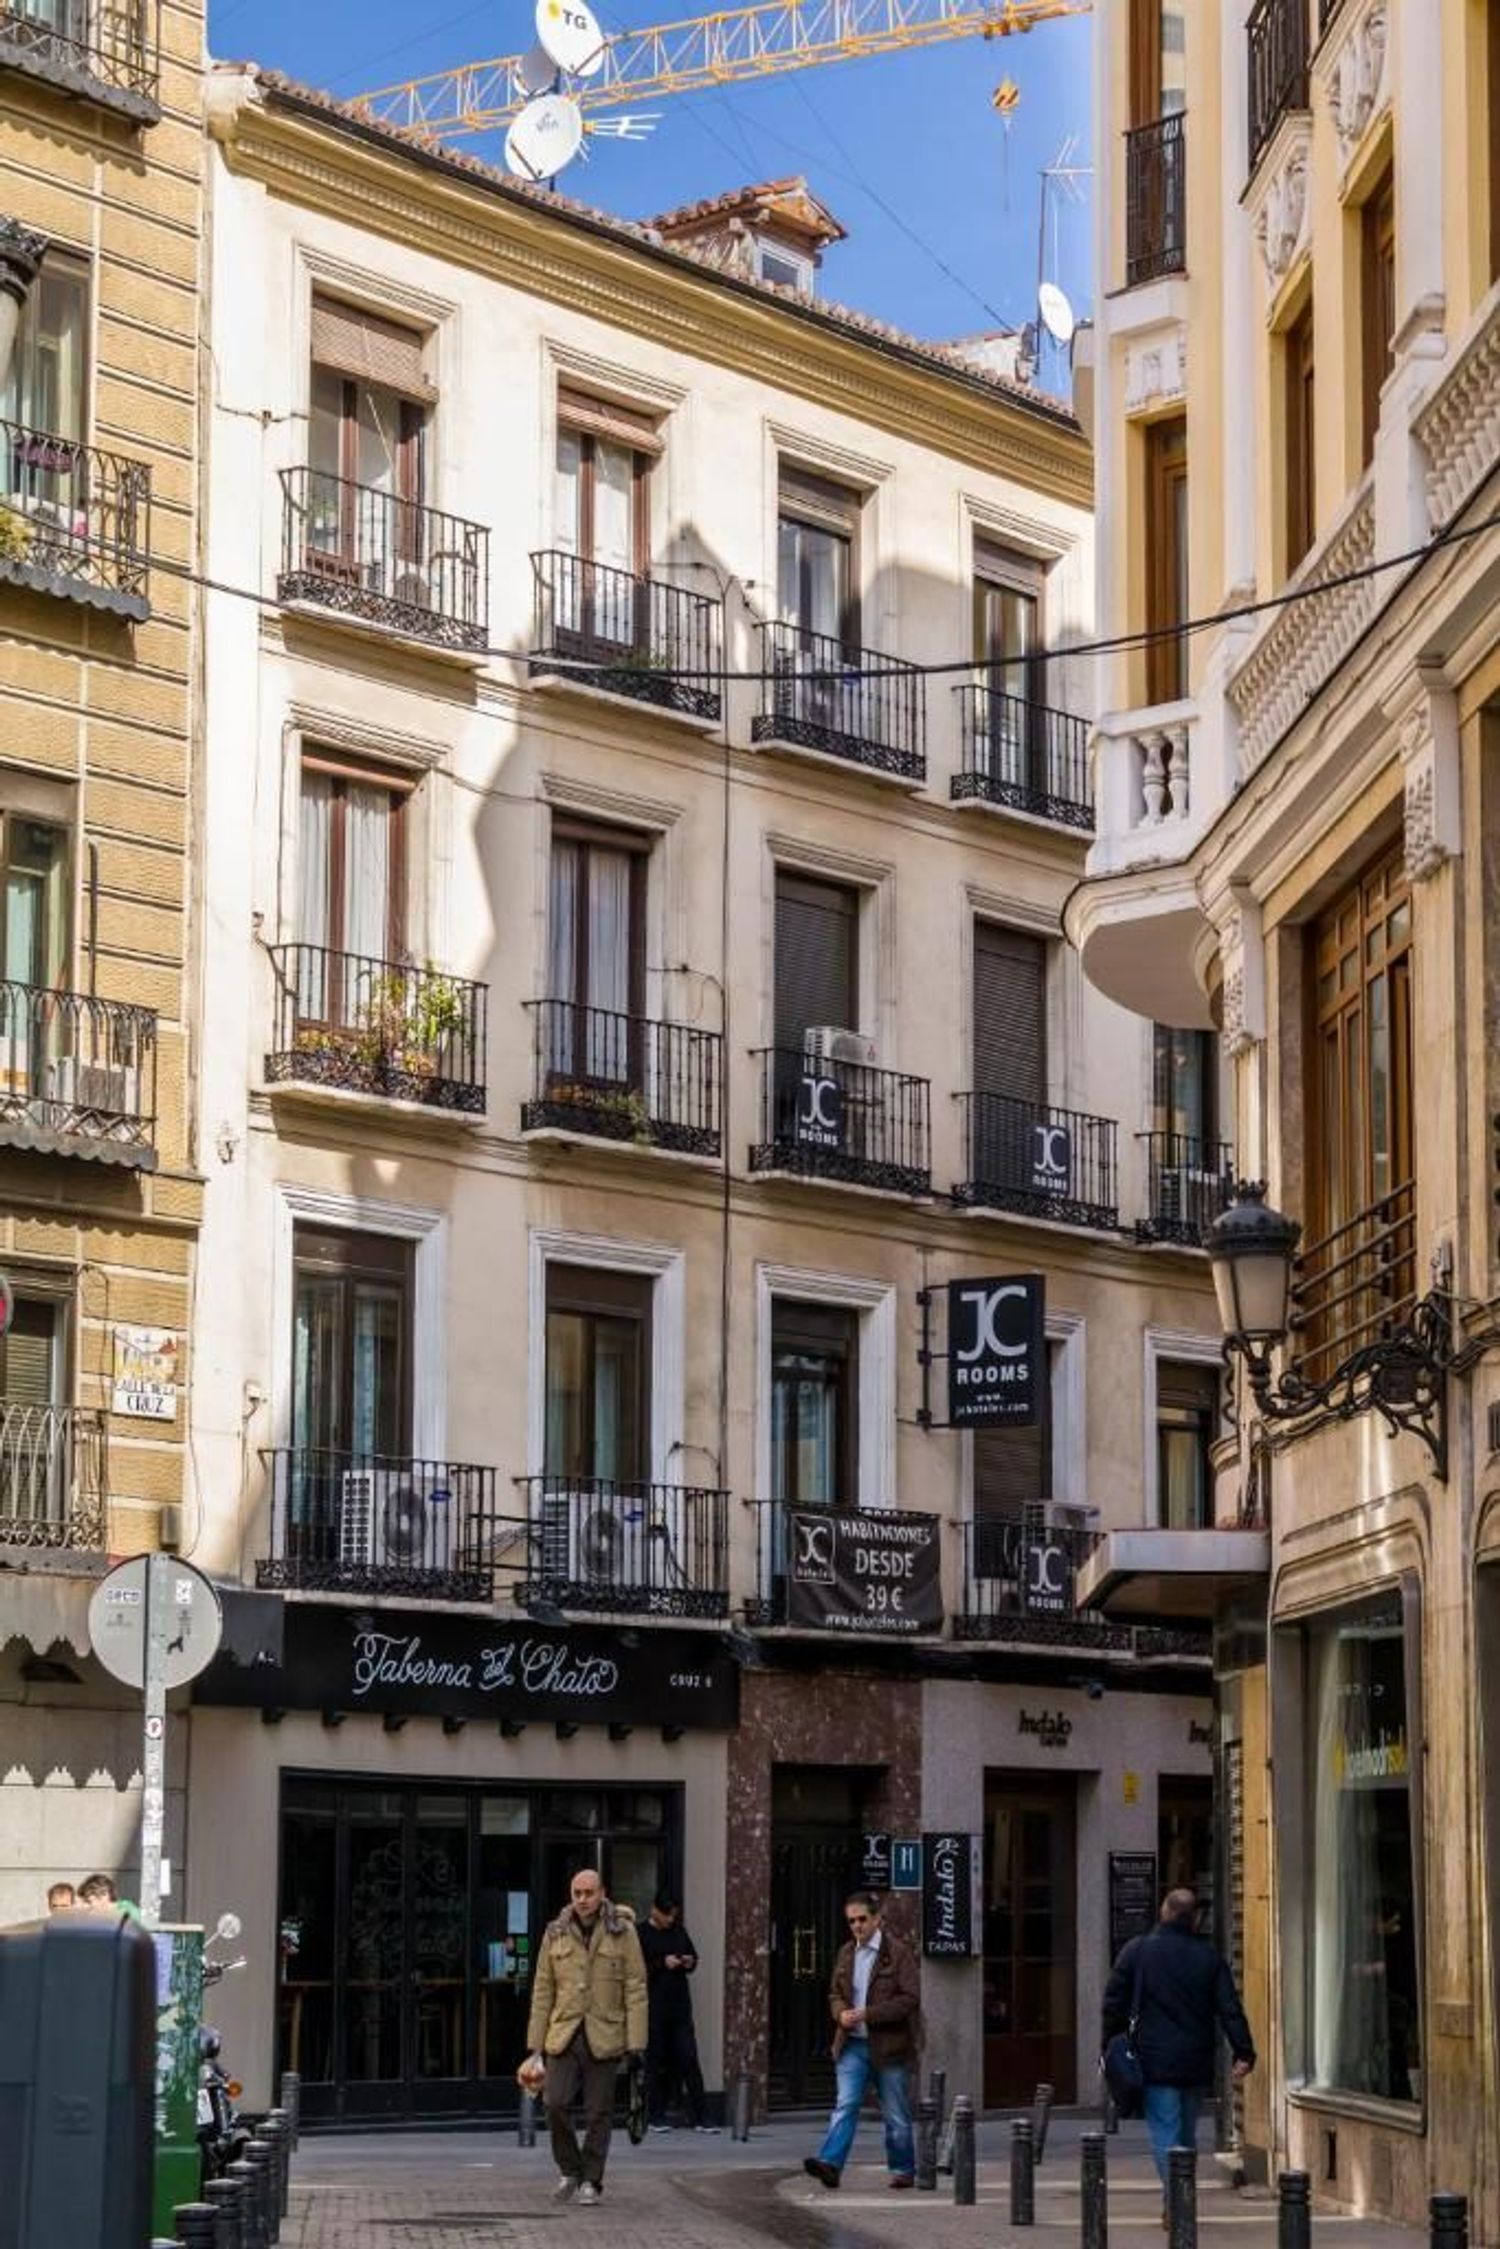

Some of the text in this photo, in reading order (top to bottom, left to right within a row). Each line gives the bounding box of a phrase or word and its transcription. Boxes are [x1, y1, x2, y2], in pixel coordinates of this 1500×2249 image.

[563, 9, 588, 30] TG
[957, 1284, 1028, 1362] JC
[957, 1364, 1029, 1385] ROOMS
[840, 1520, 932, 1546] HABITACIONES
[855, 1548, 915, 1578] DESDE
[866, 1583, 888, 1611] 39
[352, 1633, 471, 1694] Taberna
[520, 1639, 618, 1694] Chato
[935, 1858, 956, 1938] Indalo
[927, 1941, 967, 1953] TAPAS
